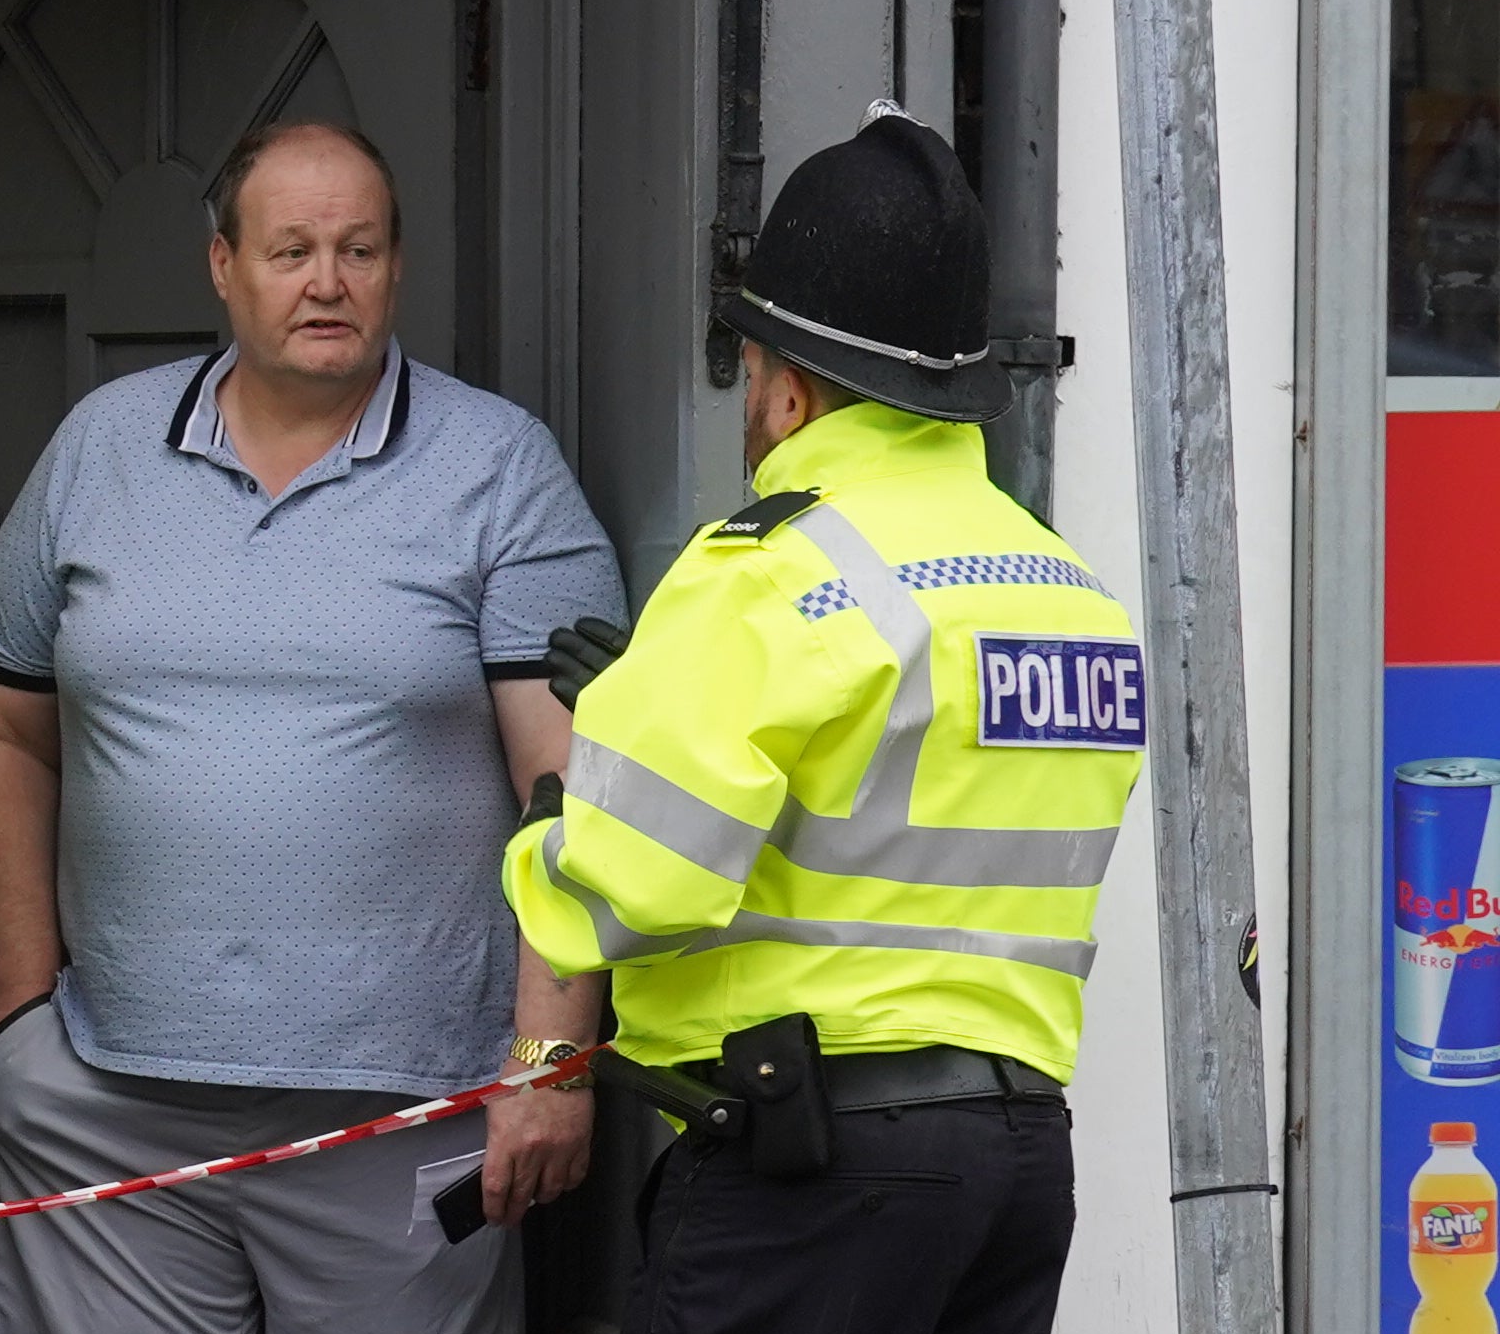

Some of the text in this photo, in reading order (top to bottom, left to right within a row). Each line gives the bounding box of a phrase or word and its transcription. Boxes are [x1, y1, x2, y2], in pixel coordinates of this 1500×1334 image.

[988, 652, 1141, 731] POLICE
[1399, 880, 1459, 920] Red
[1422, 1214, 1483, 1238] FANTA
